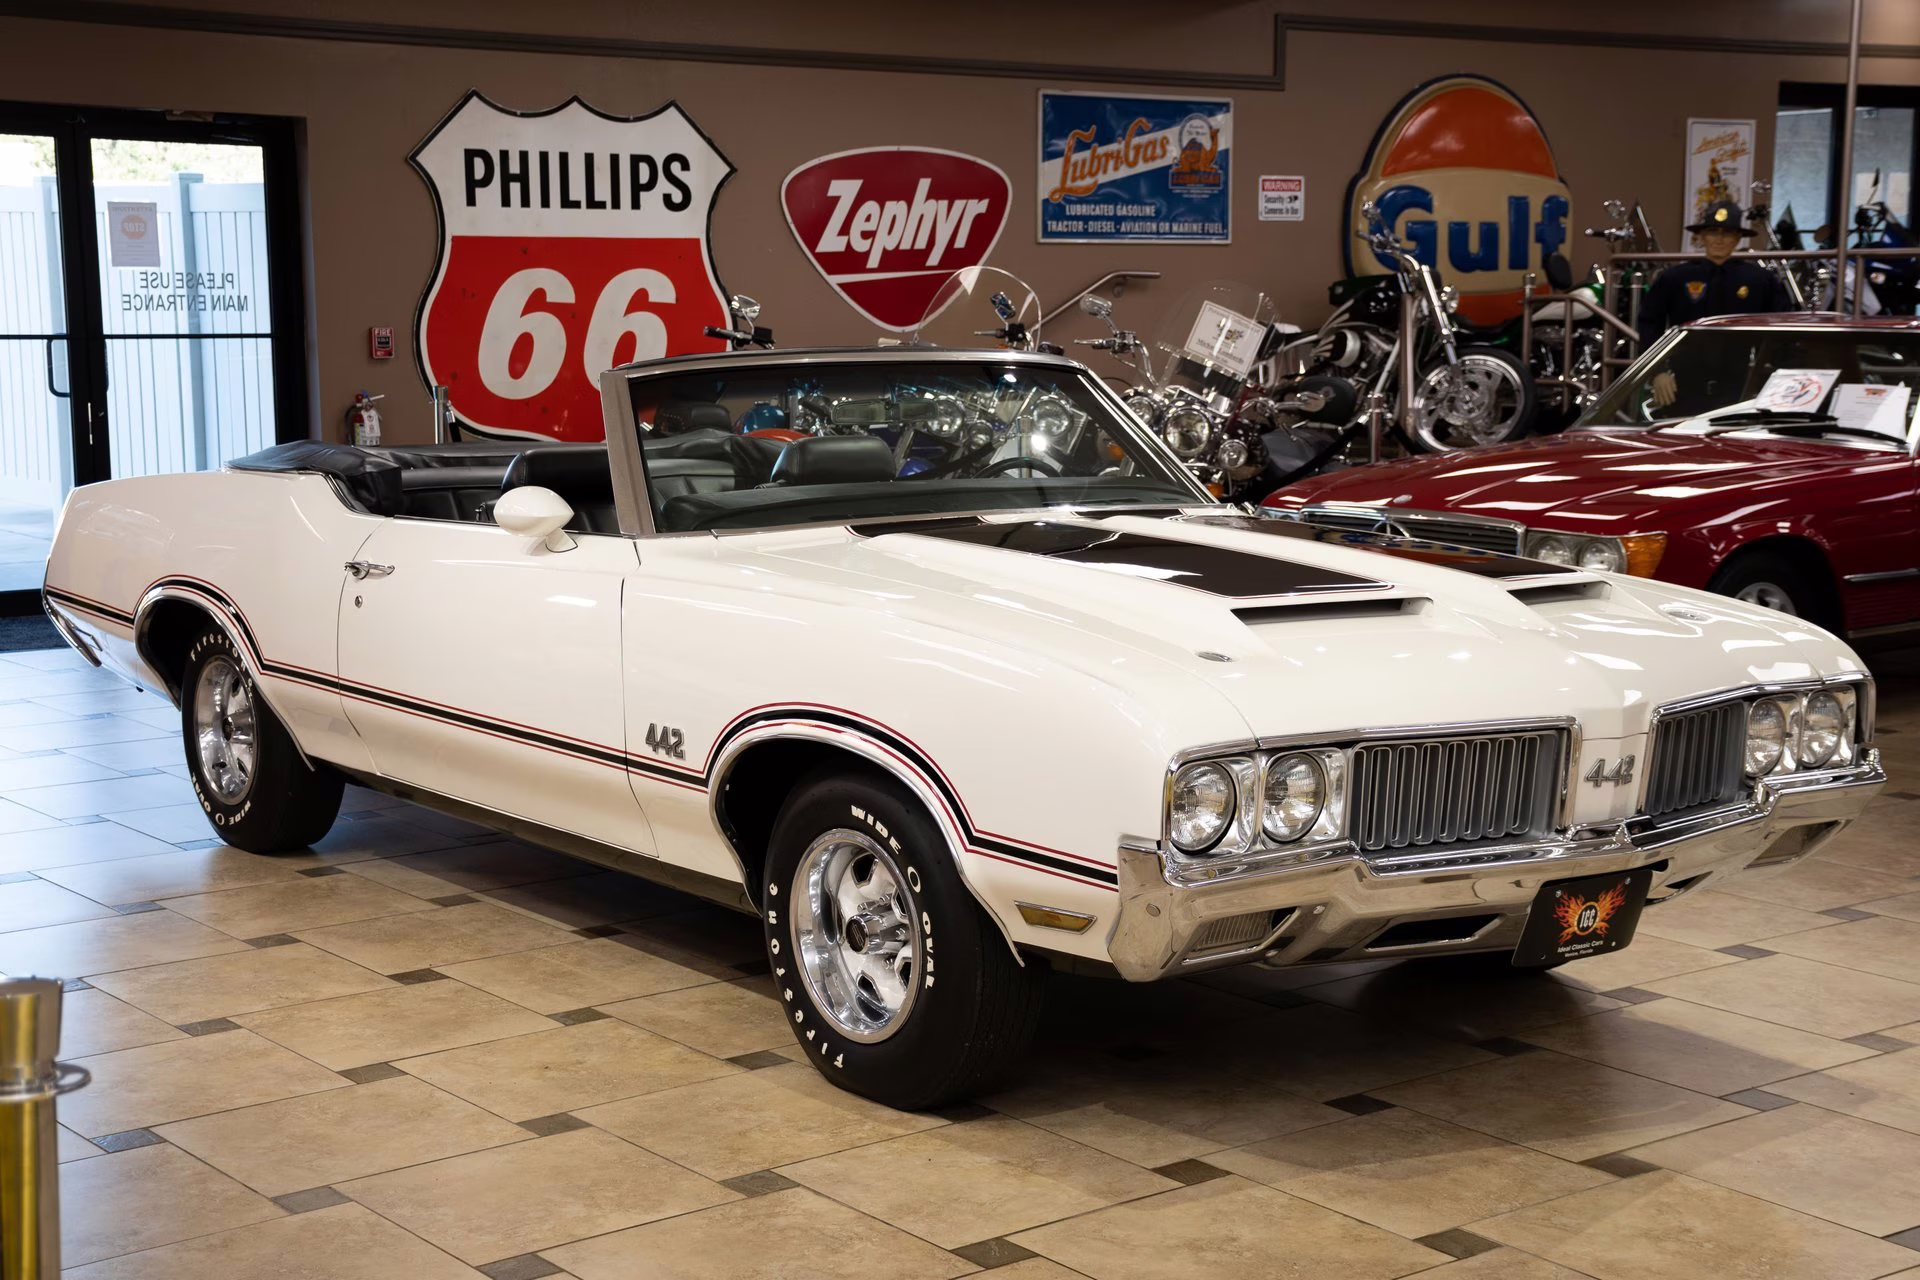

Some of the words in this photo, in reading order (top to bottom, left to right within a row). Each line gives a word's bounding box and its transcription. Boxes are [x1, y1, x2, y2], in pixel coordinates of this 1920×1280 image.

[464, 148, 692, 212] PHILLIPS
[1263, 181, 1300, 191] WARNING
[815, 178, 990, 268] Zephyr
[1065, 204, 1114, 216] LUBRICATED
[1116, 204, 1156, 217] GASOLINE
[1159, 222, 1170, 233] OR
[1172, 222, 1202, 234] MARINE
[1369, 184, 1569, 276] Gulf
[374, 328, 391, 336] FIRE
[478, 267, 677, 400] 66
[645, 722, 685, 760] 442
[850, 804, 902, 855] WIDE
[922, 911, 935, 990] OVAL
[1557, 945, 1572, 953] Ideal
